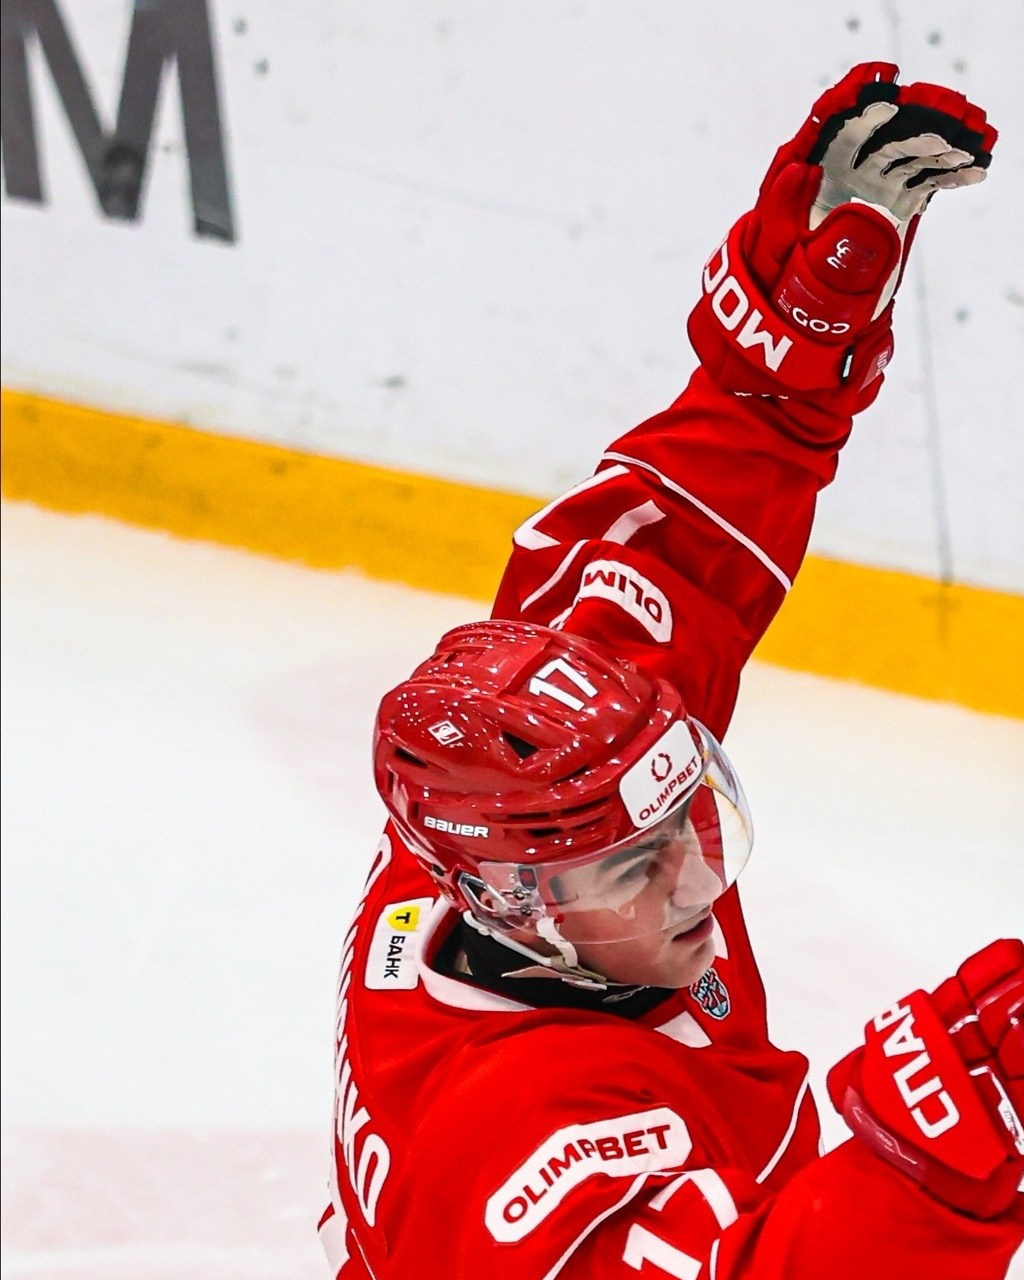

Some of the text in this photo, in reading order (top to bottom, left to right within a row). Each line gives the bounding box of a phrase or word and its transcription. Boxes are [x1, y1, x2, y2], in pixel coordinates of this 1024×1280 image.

[528, 657, 599, 712] 17
[639, 755, 698, 821] OLIMPBET
[423, 815, 489, 839] BAUER
[383, 935, 406, 979] БАНК
[872, 1002, 960, 1139] СПАР
[502, 1124, 671, 1224] OLIMPBET
